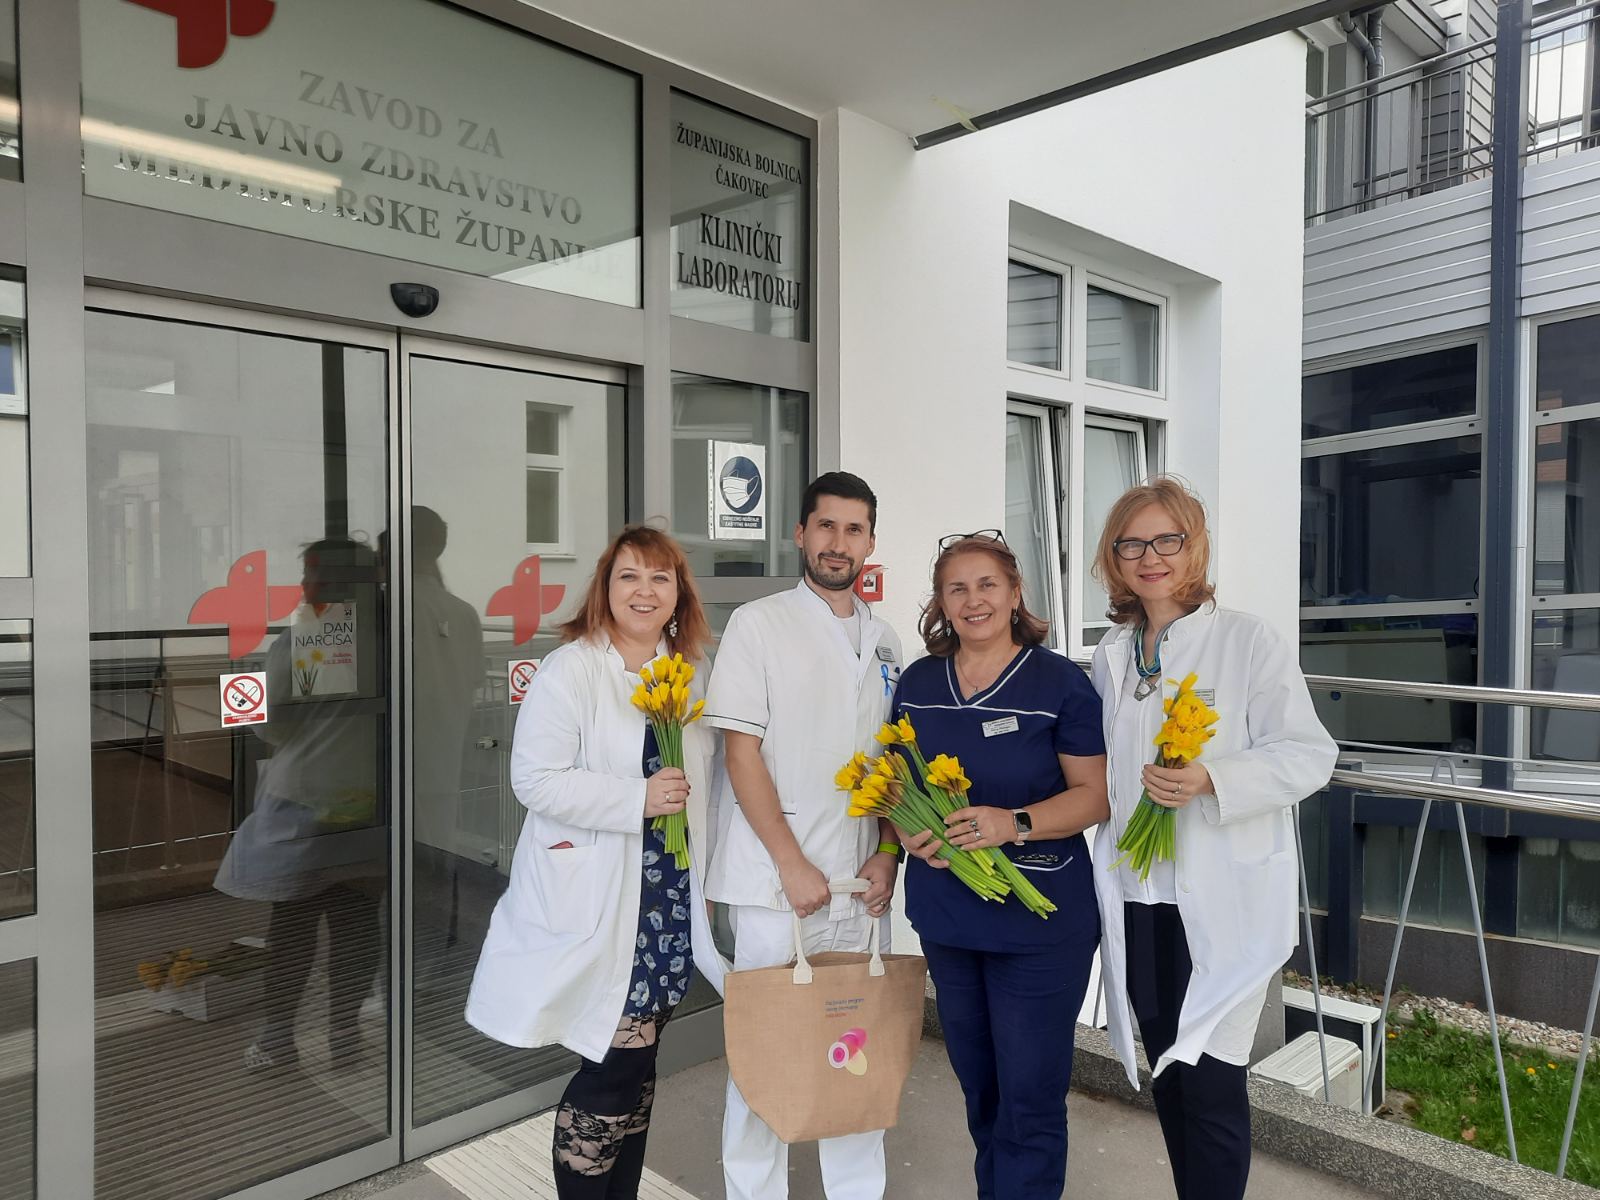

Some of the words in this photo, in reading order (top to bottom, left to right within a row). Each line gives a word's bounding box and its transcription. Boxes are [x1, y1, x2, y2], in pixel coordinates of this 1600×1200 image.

[298, 70, 443, 140] ZAVOD
[457, 117, 504, 159] ZA
[184, 95, 345, 165] JAVNO
[360, 140, 583, 226] ZDRAVSTVO
[677, 122, 752, 168] ŽUPANIJSKA
[755, 152, 803, 185] BOLNICA
[715, 163, 769, 200] ČAKOVEC
[700, 212, 783, 265] KLINIČKI
[677, 251, 803, 311] LABORATORIJ
[295, 633, 353, 647] NARCISA
[323, 622, 353, 634] DAN
